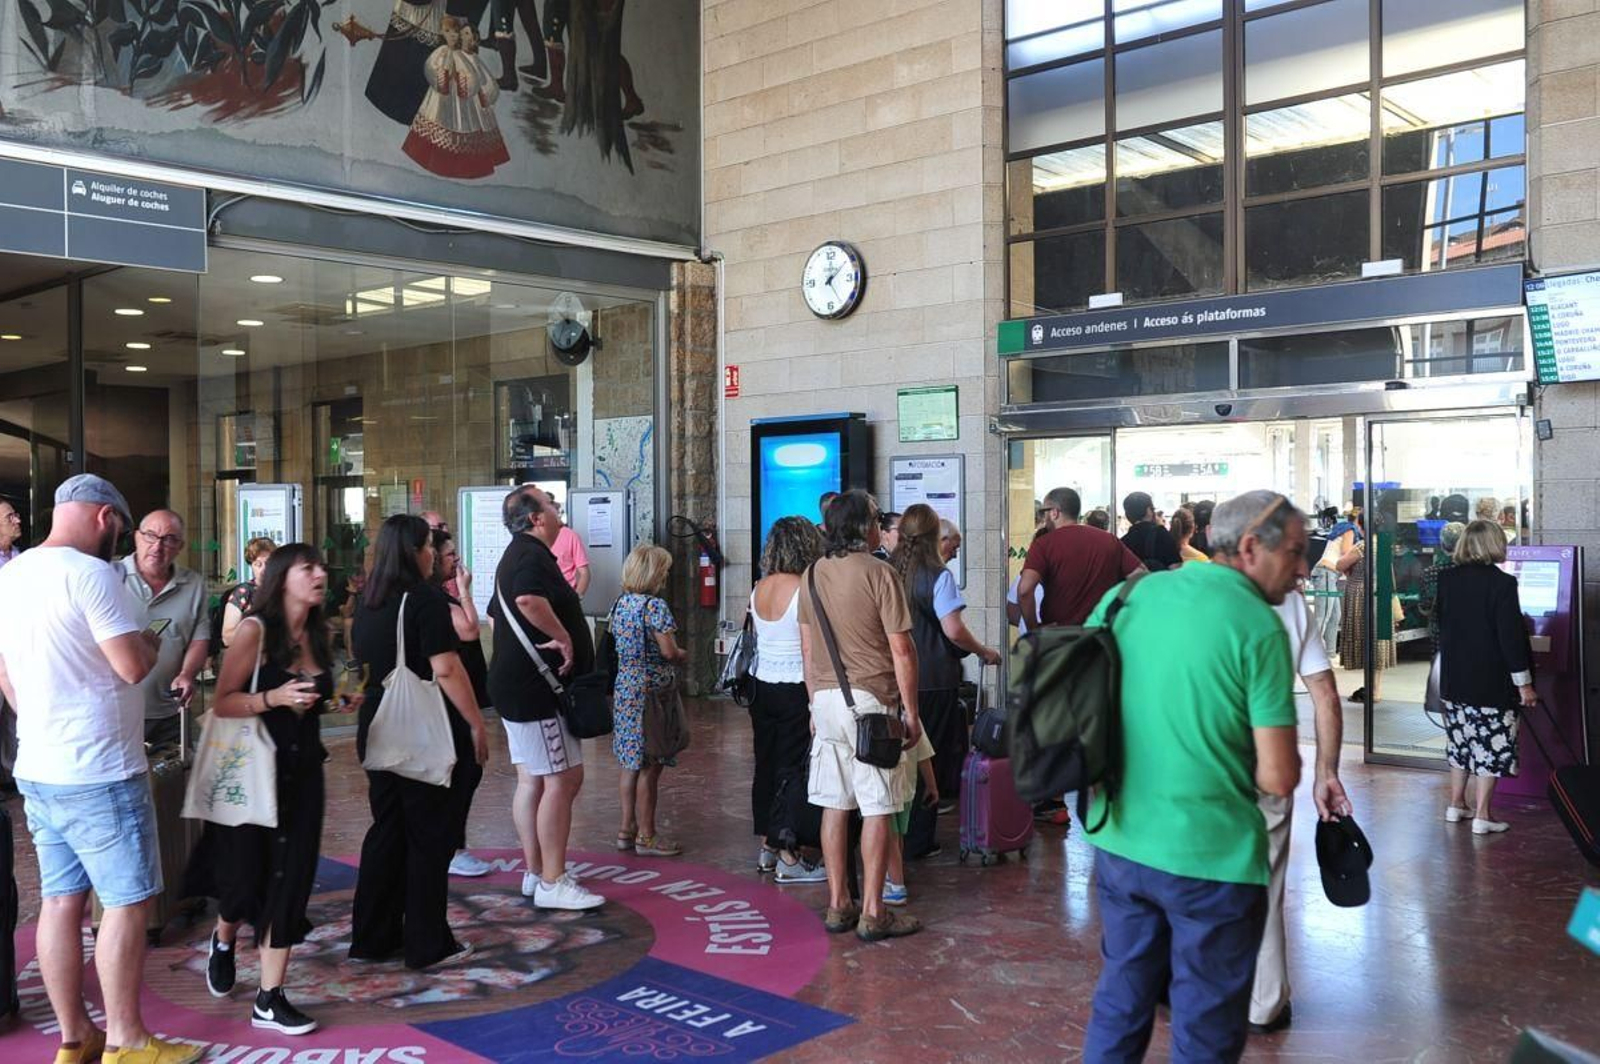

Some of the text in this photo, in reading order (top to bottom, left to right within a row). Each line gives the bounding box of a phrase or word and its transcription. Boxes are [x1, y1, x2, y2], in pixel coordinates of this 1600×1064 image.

[91, 181, 168, 201] Alquiler de coches
[91, 192, 170, 212] Aluguer de coches
[826, 251, 836, 261] 12
[846, 272, 853, 283] 3
[827, 301, 834, 310] 6
[1143, 304, 1266, 328] Acceso ás plataformas
[1051, 320, 1128, 339] Acceso andenes
[648, 880, 726, 901] EN
[684, 900, 773, 956] ESTÁS
[615, 985, 768, 1038] A FEIRA
